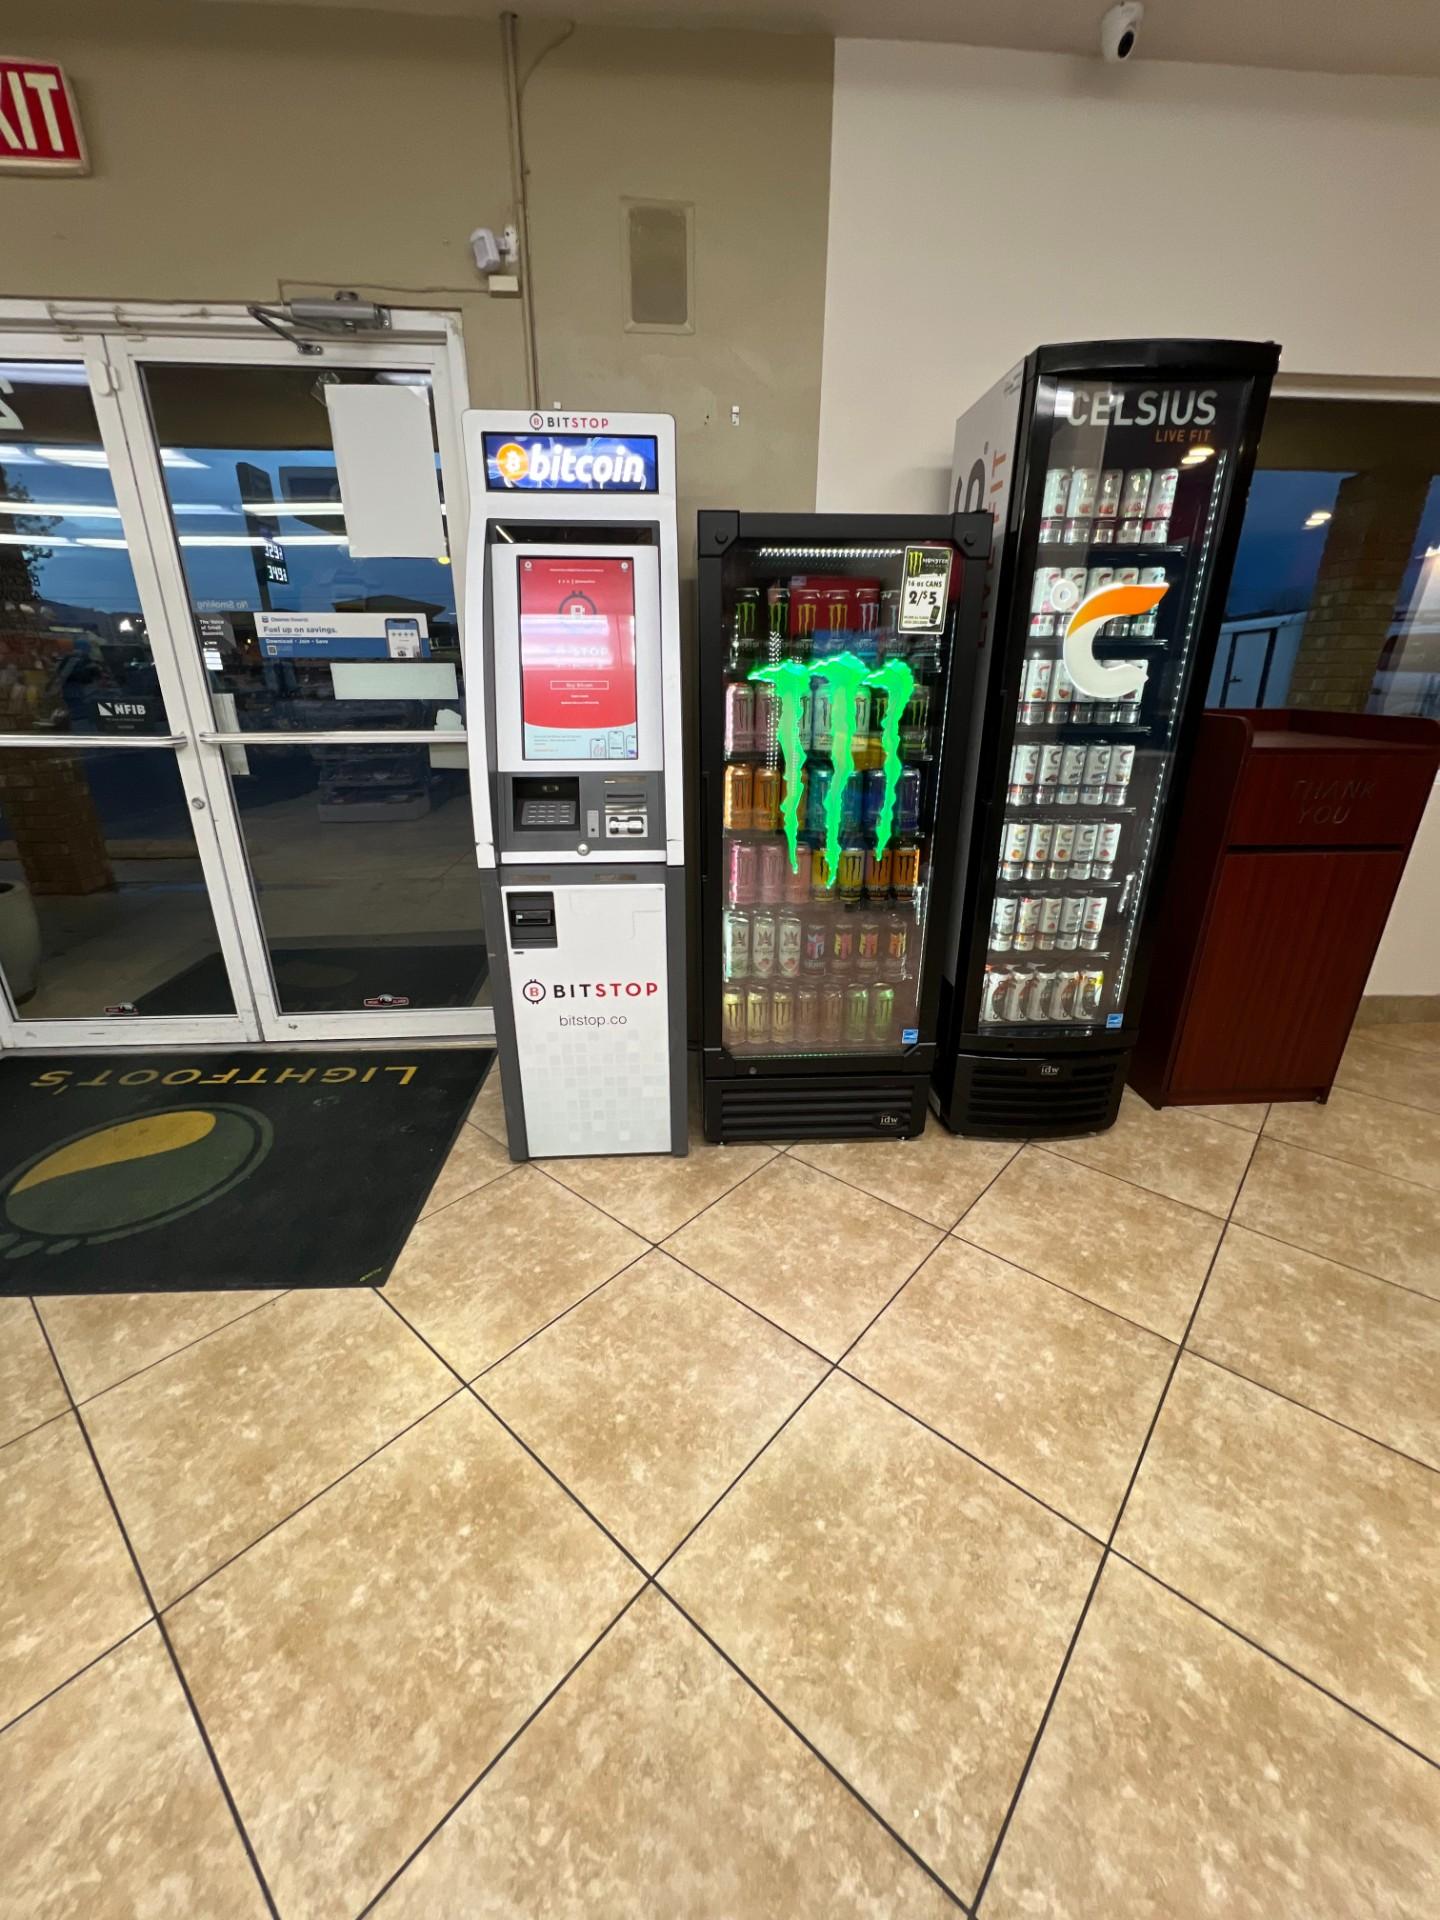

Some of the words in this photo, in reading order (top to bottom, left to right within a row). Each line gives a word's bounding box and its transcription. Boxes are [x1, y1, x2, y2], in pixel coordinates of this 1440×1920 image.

[0, 71, 65, 152] IT
[1068, 390, 1218, 426] CELSIUS
[547, 417, 609, 428] BITSTOP
[1155, 429, 1186, 443] LIVE
[1189, 429, 1211, 443] FIT
[529, 443, 645, 483] bitcoin
[263, 625, 280, 633] Fuel
[282, 627, 292, 635] up
[114, 703, 146, 715] NFIB
[1298, 805, 1350, 825] YOU
[553, 982, 658, 998] BITSTOP
[559, 1015, 628, 1028] bitstop.co
[30, 1065, 419, 1095] LIGHTFOOT'S
